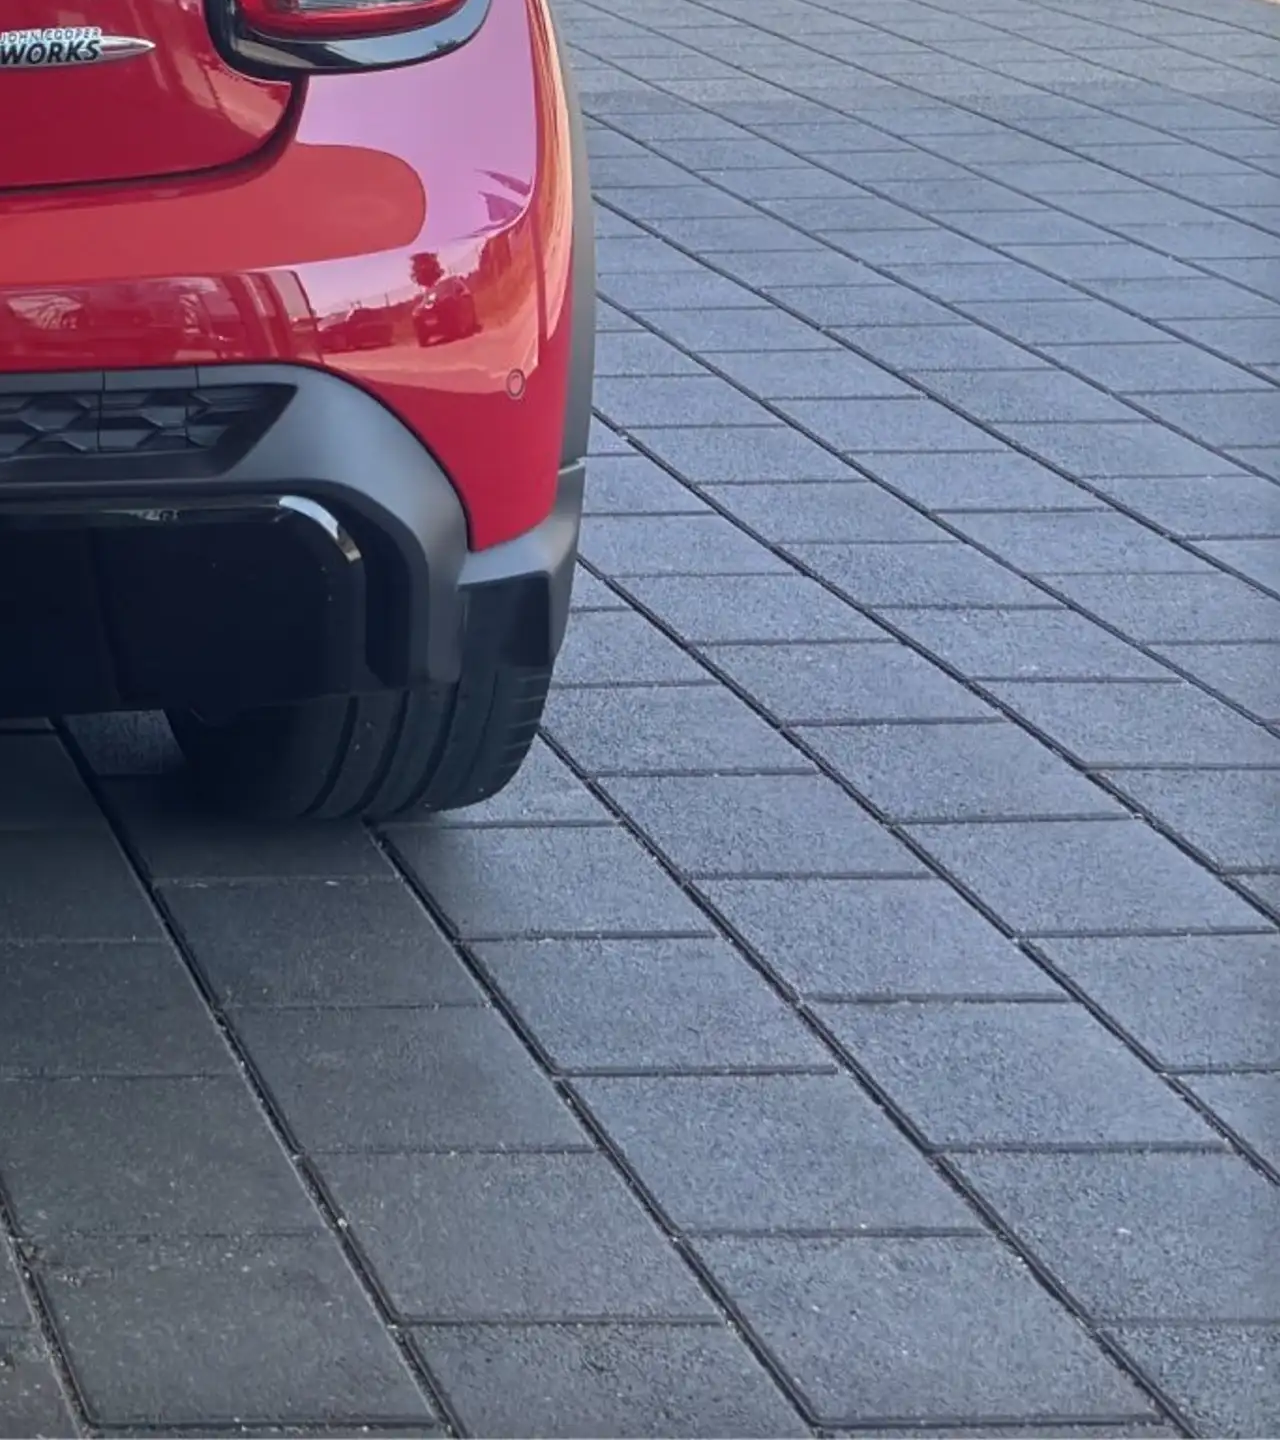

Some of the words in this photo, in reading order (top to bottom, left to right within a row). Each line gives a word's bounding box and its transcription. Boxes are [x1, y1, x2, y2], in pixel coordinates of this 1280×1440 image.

[0, 31, 40, 44] JOHN
[44, 28, 100, 40] COOPER
[0, 39, 100, 65] WORKS
